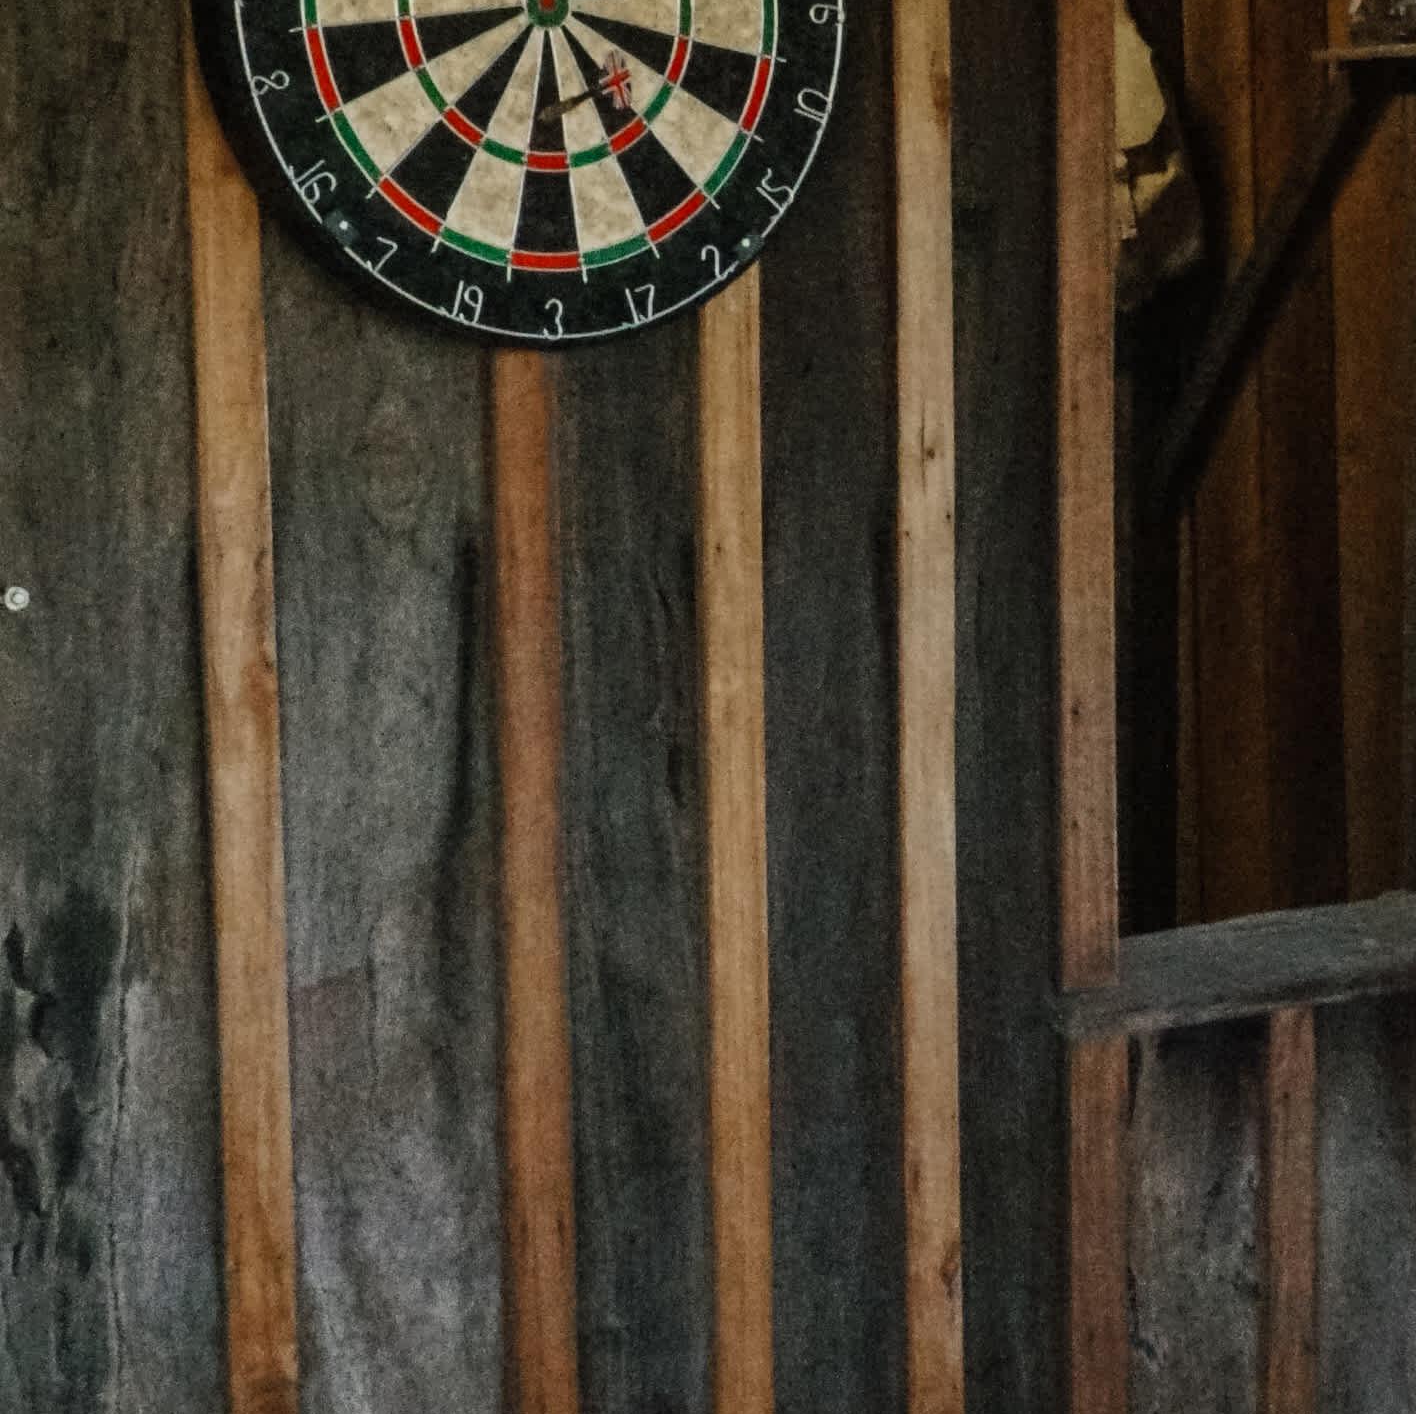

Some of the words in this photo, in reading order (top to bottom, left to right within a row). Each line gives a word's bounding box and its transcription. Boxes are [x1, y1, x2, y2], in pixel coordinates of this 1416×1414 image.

[809, 3, 845, 27] 6
[250, 69, 290, 97] 8
[794, 87, 831, 138] 10
[288, 159, 338, 204] 16
[756, 168, 794, 221] 15
[701, 244, 740, 280] 2
[440, 280, 484, 325] 19
[541, 298, 564, 339] 3
[622, 284, 656, 328] 17
